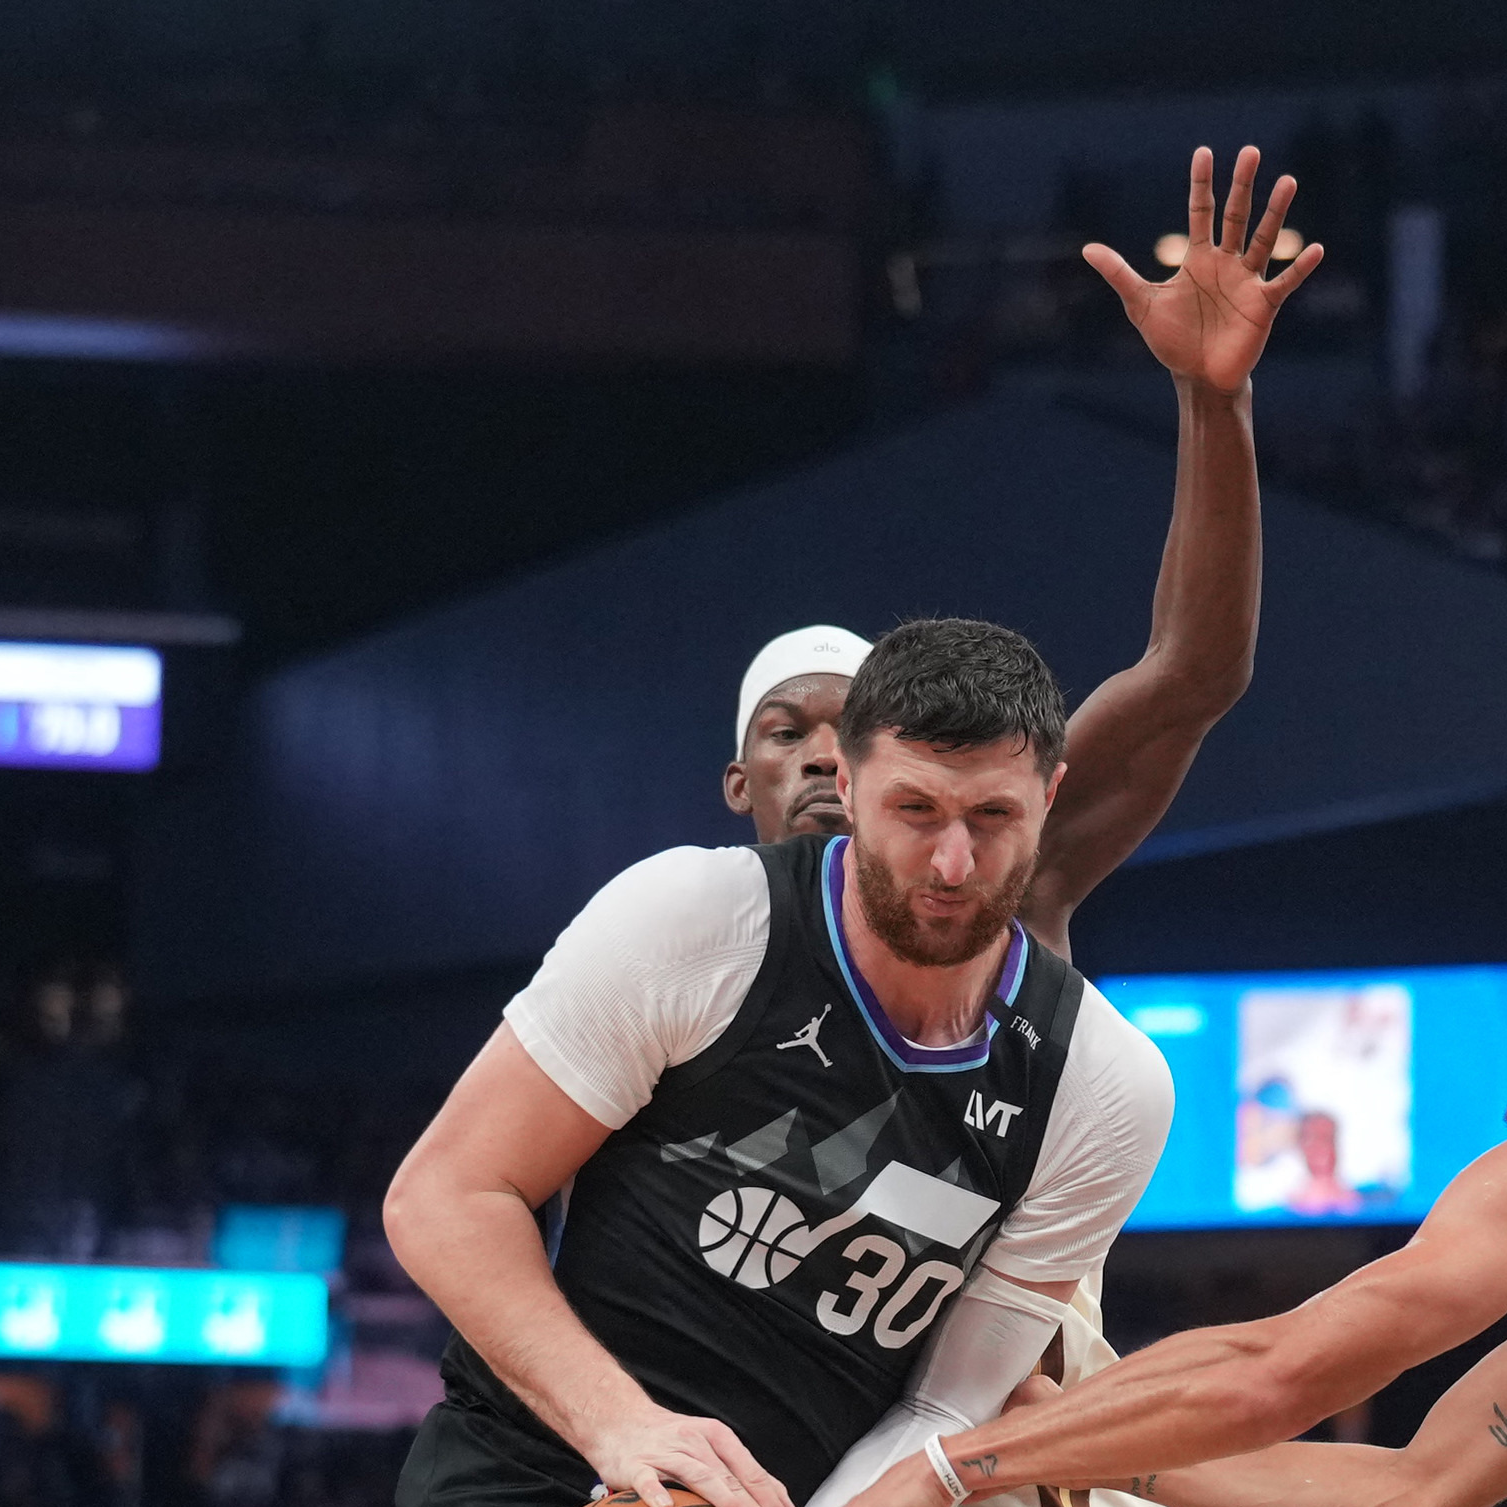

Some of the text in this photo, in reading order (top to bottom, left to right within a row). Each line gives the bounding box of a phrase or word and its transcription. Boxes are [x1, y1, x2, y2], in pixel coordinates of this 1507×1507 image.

[813, 642, 841, 654] alo
[1010, 1015, 1042, 1050] FRANK
[964, 1089, 1024, 1138] LVT
[816, 1234, 965, 1349] 30
